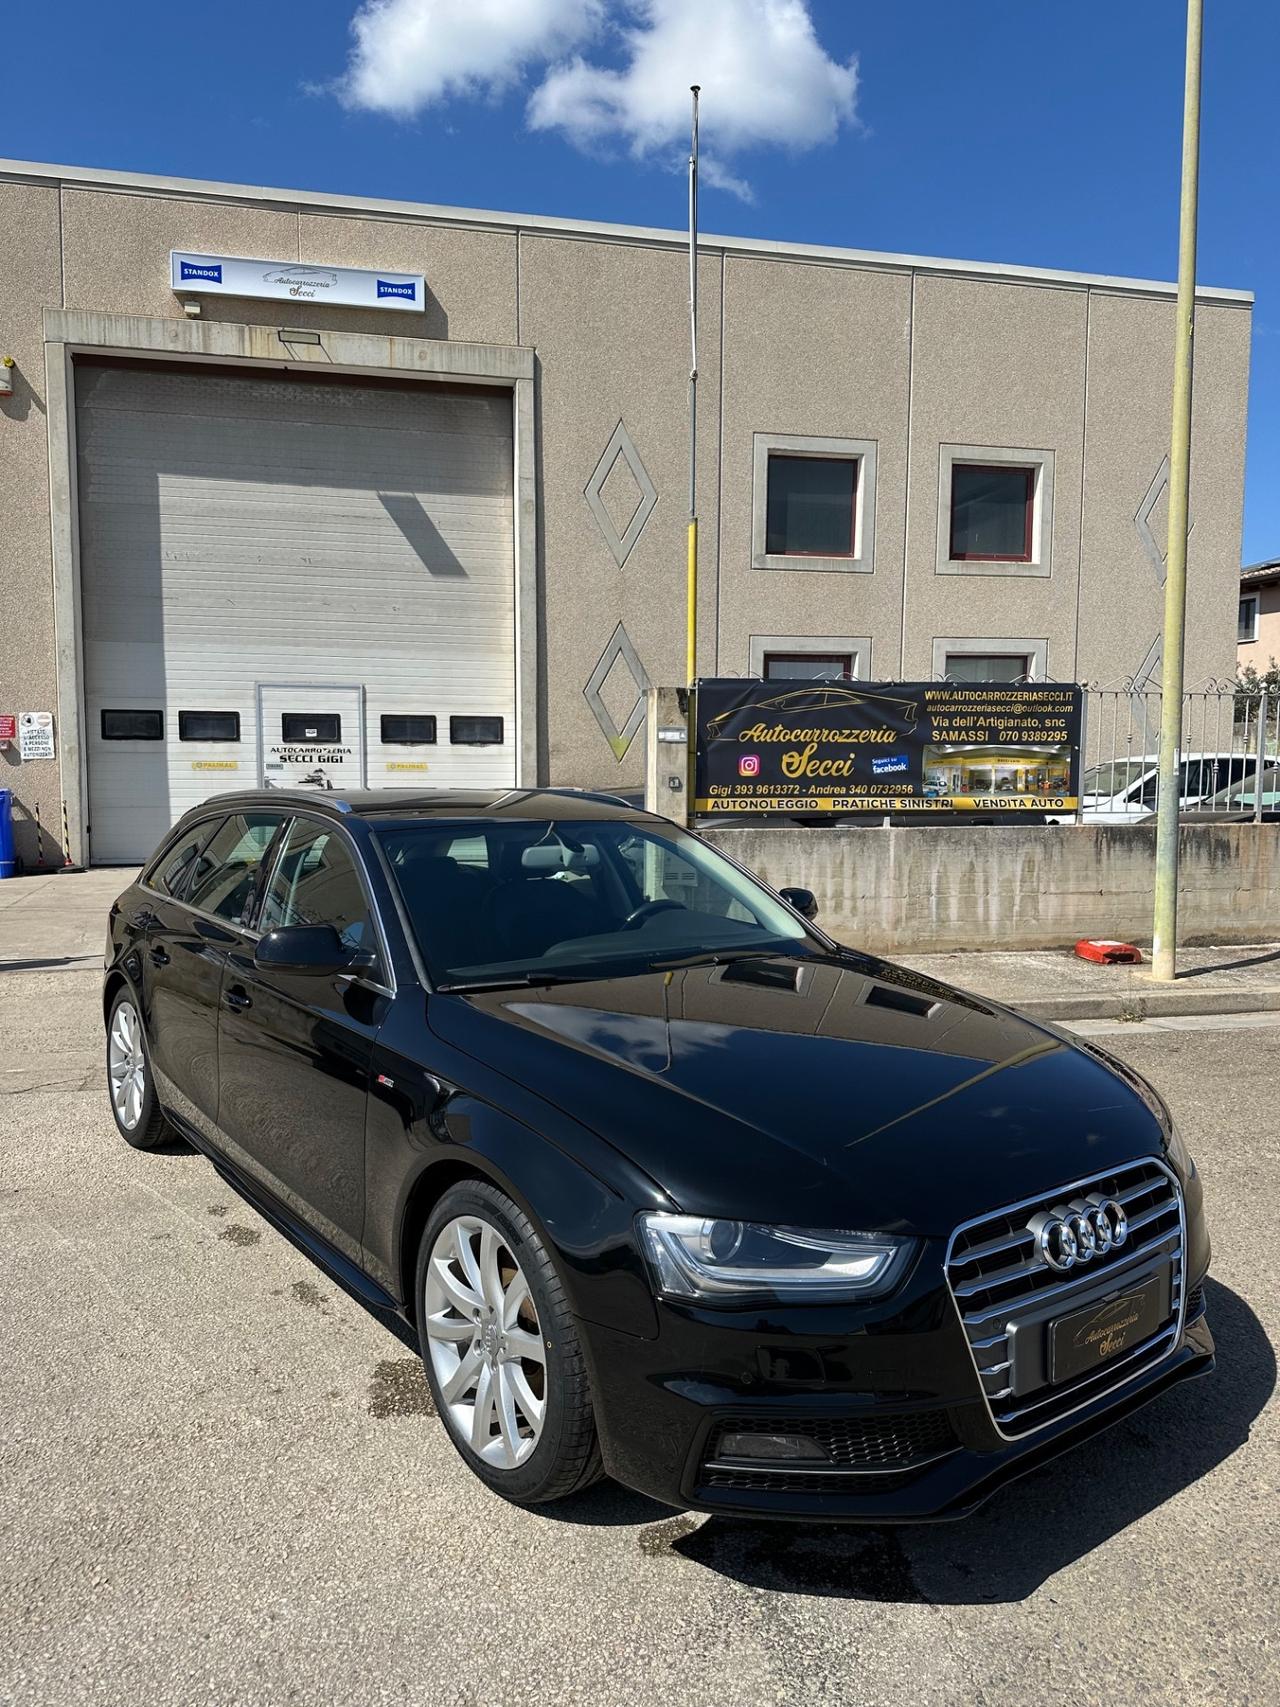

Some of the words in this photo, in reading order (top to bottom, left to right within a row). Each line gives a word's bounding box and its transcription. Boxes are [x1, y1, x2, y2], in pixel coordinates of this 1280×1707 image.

[183, 268, 220, 278] STANDOX
[274, 276, 330, 288] Autocarrozzeria
[289, 286, 316, 298] Secci
[379, 286, 413, 295] STANDOX
[924, 690, 1074, 701] WWW.AUTOCARROZZERIASECCI.IT
[926, 704, 1073, 714] autocarrozzeriasecci@outlook.com
[931, 717, 951, 727] Via
[1045, 718, 1065, 727] snc
[738, 723, 897, 743] Autocarrozzeria
[931, 731, 989, 741] SAMASSI
[999, 731, 1019, 741] 070
[1021, 731, 1068, 741] 9389295
[280, 754, 313, 764] SECCI
[318, 755, 344, 764] GIGI
[781, 742, 856, 778] Secci
[872, 757, 891, 765] Seguici
[872, 762, 907, 774] facebook
[709, 785, 732, 797] Gigi
[734, 785, 753, 795] 393
[756, 785, 800, 795] 9613372
[808, 784, 846, 795] Andrea
[849, 785, 867, 795] 340
[869, 784, 914, 795] 0732956
[711, 799, 819, 810] AUTONOLEGGIO
[832, 799, 896, 809] PRATICHE
[900, 799, 953, 809] SINISTRI
[973, 799, 1026, 809] VENDITA
[1031, 798, 1064, 808] AUTO
[1099, 1332, 1126, 1356] Secci
